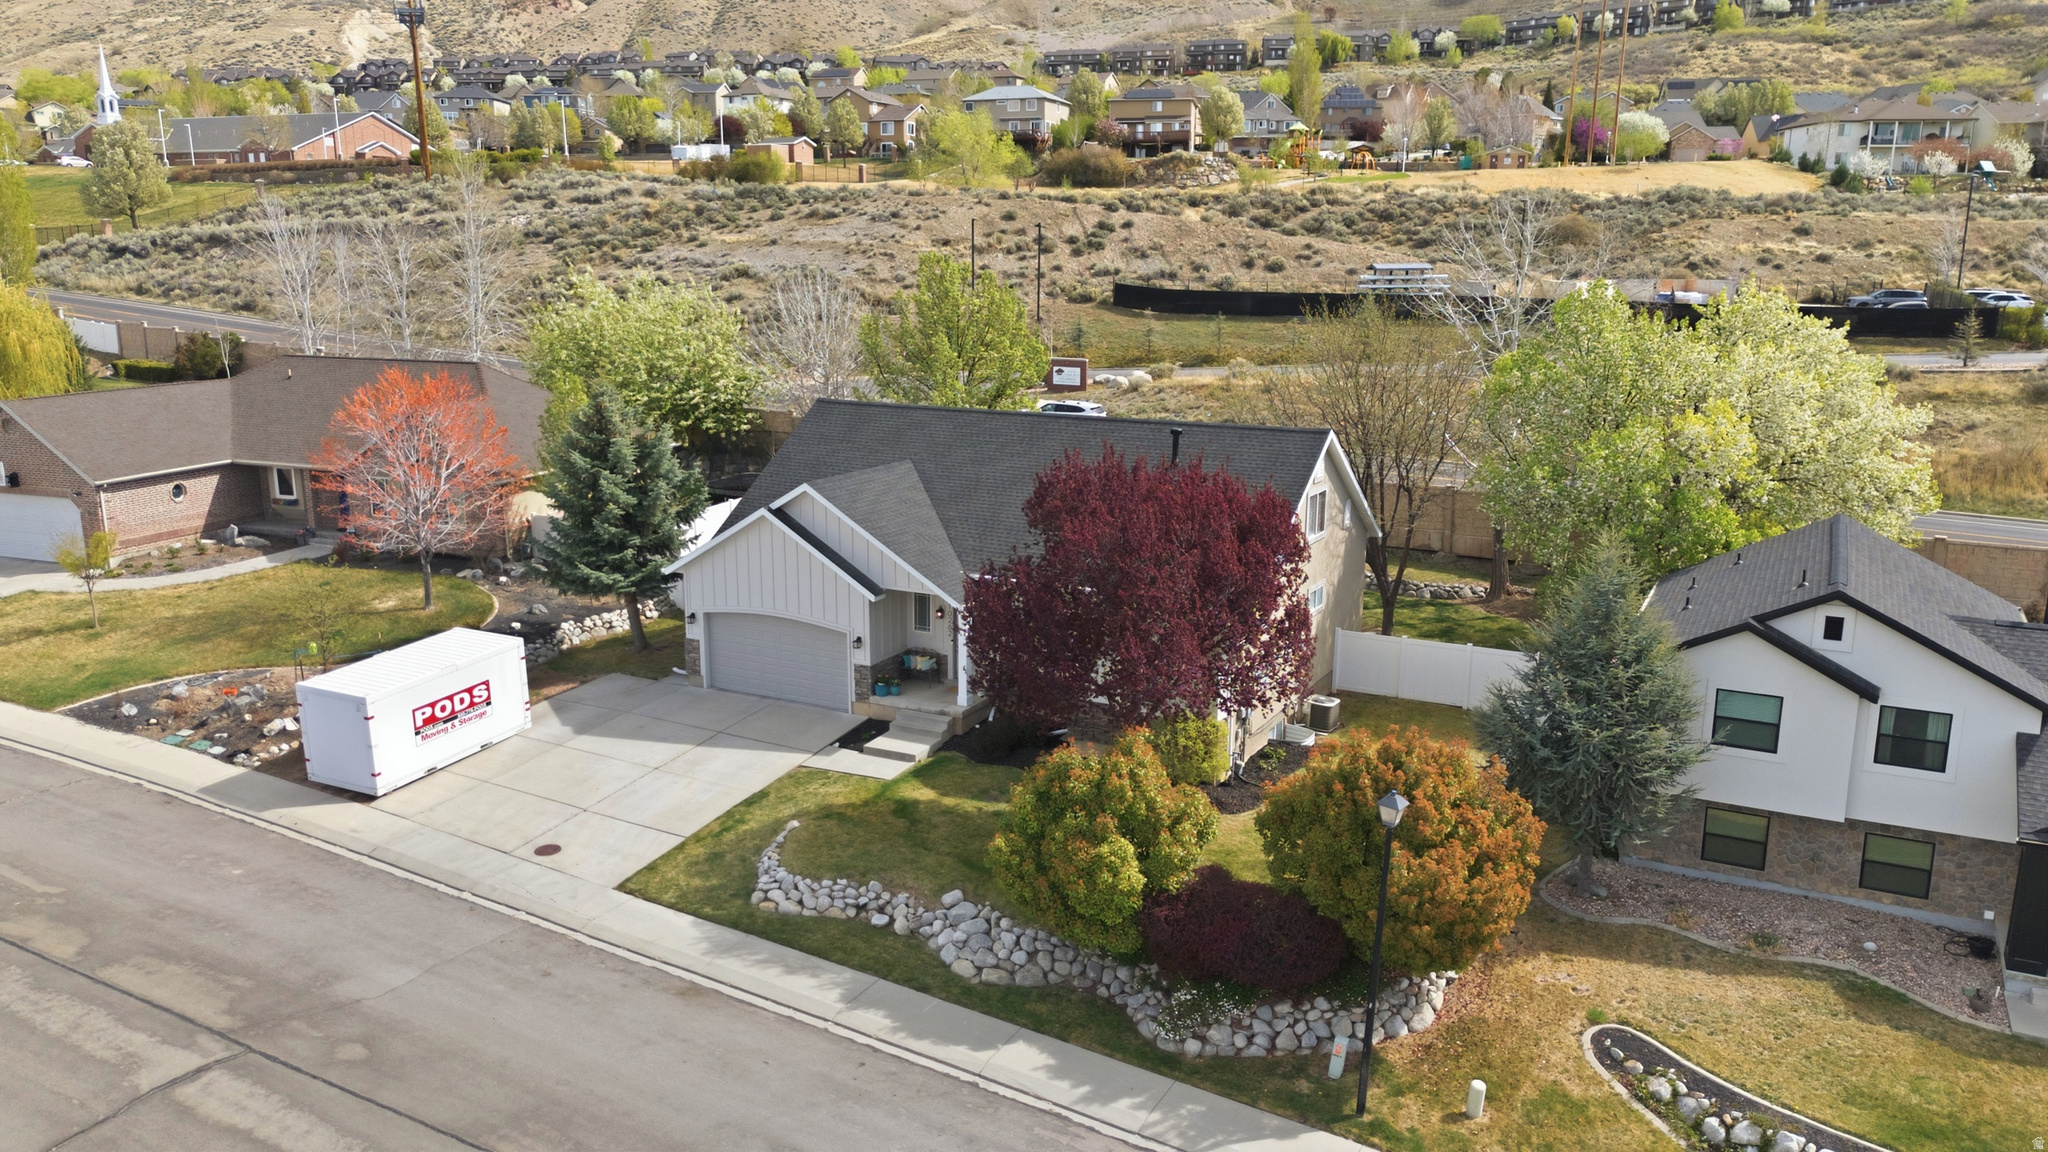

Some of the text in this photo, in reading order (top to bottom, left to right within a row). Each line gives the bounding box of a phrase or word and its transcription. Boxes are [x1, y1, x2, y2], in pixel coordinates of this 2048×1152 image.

[414, 684, 489, 728] PODS
[421, 726, 449, 742] Moving
[450, 722, 457, 730] &
[458, 710, 488, 726] Storage
